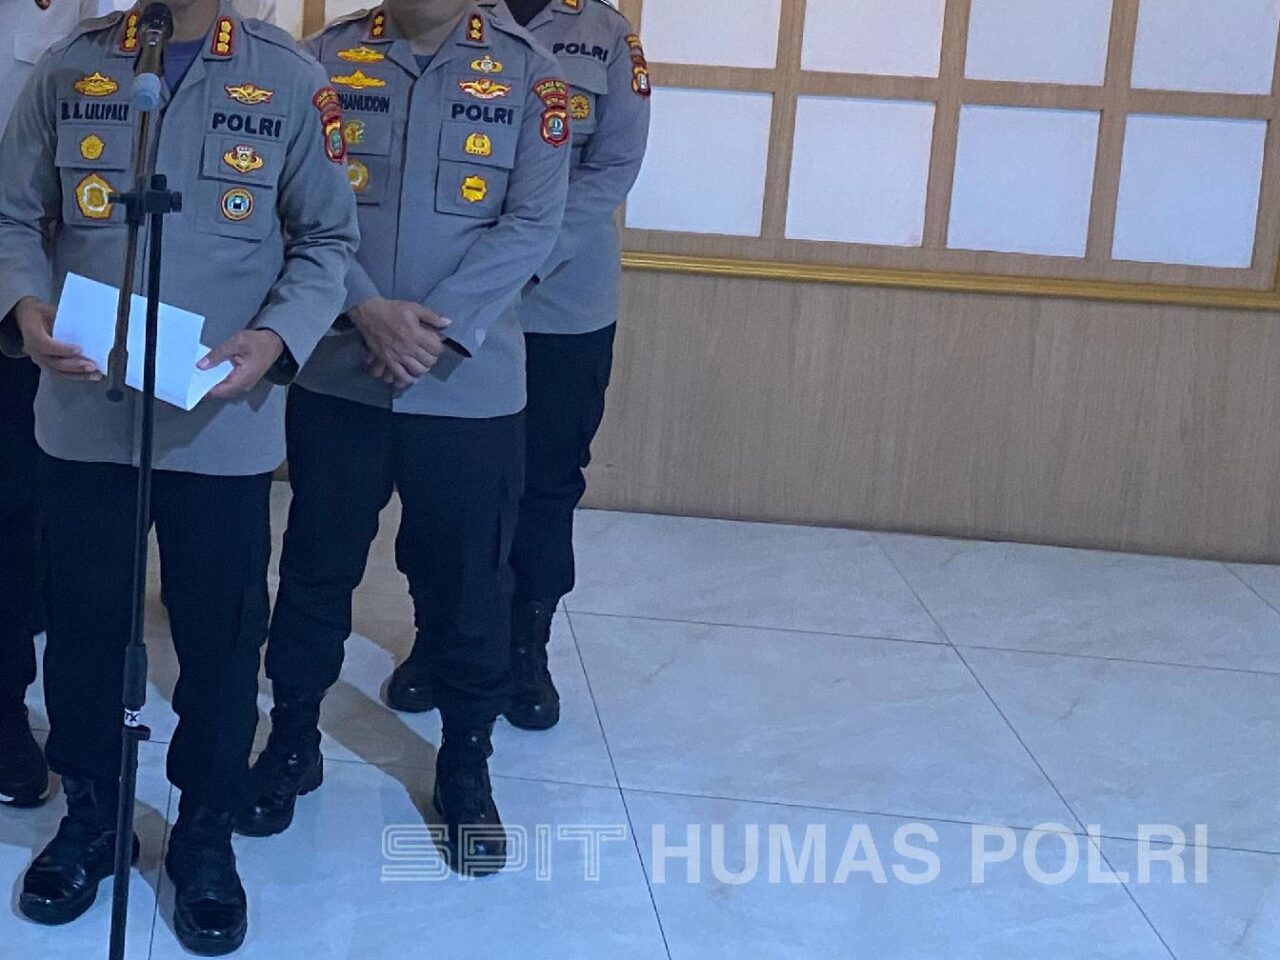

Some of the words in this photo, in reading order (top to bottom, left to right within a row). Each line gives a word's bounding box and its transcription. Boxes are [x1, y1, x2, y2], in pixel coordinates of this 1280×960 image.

[552, 42, 608, 63] POLRI
[212, 112, 282, 138] POLRI
[451, 103, 514, 126] POLRI
